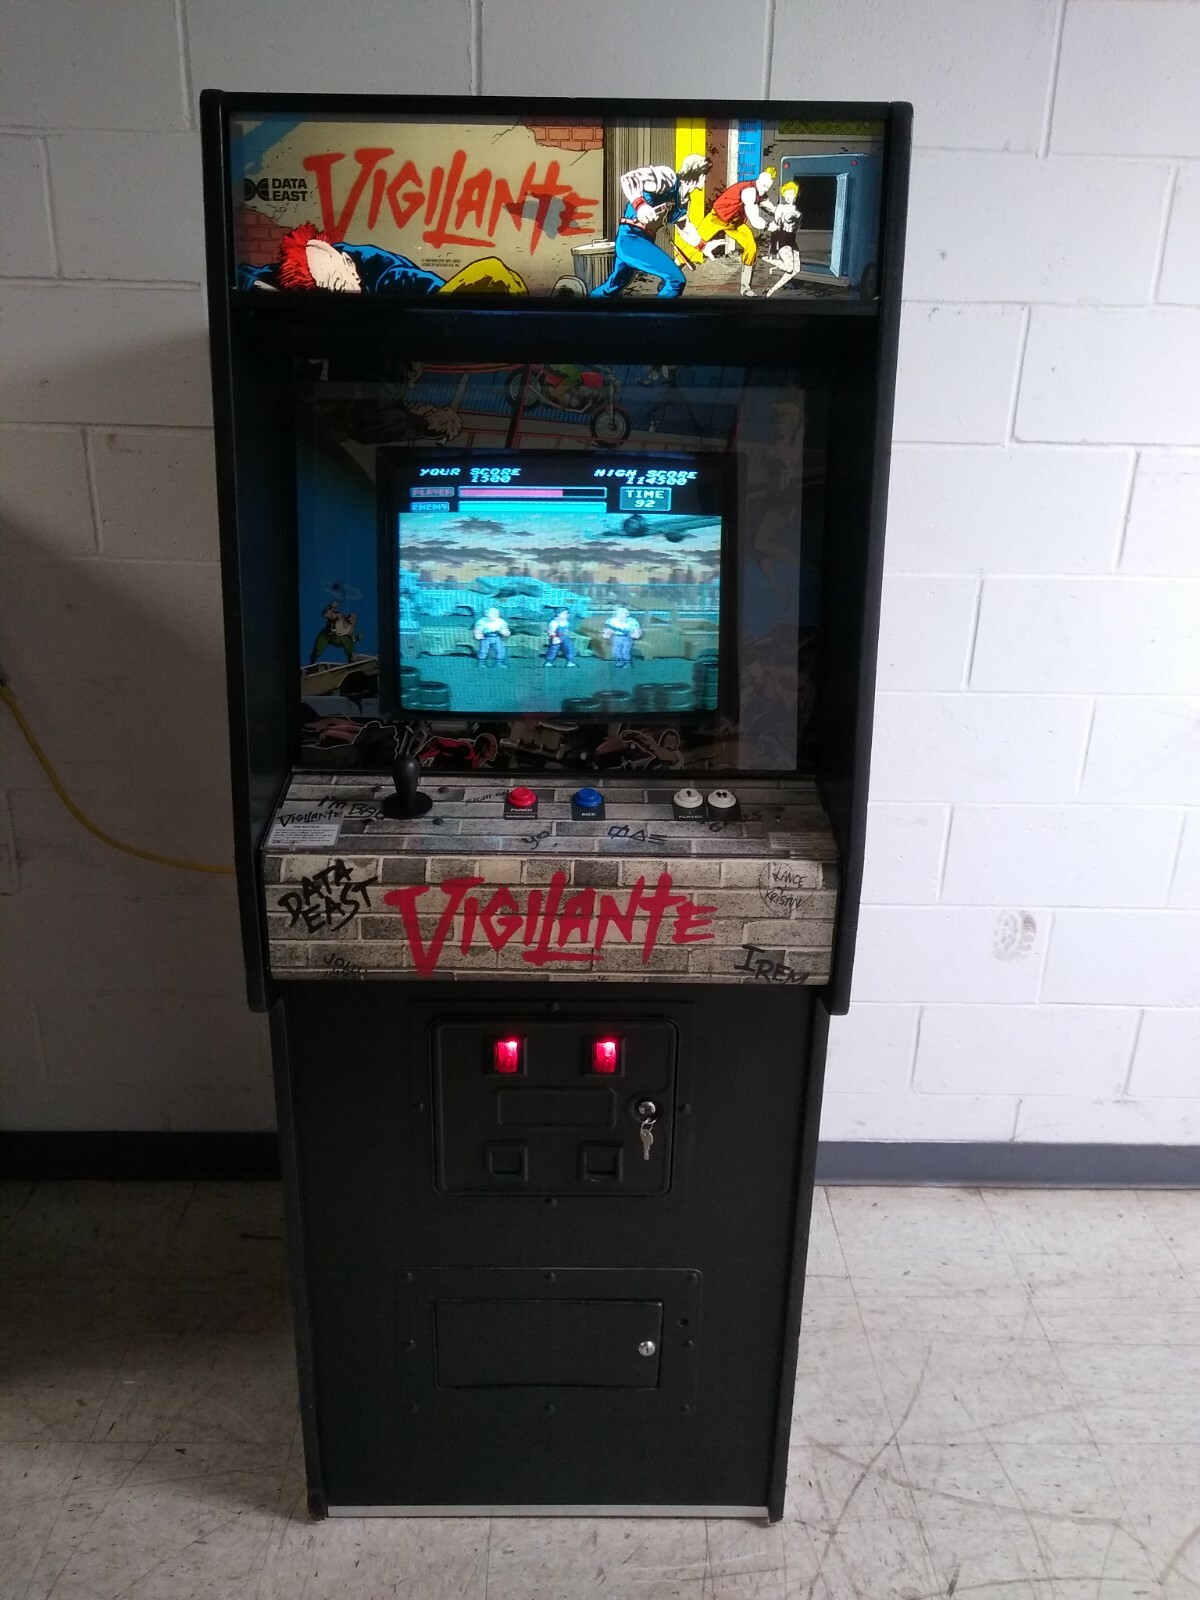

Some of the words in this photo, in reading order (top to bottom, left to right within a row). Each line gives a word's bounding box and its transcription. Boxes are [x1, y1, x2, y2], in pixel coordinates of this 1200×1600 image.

[271, 178, 308, 189] DATA
[272, 190, 308, 202] EAST
[303, 147, 600, 255] VIGILANTE
[419, 467, 461, 476] YOUR
[469, 467, 522, 476] SCORE
[593, 469, 638, 477] HIGH
[645, 469, 699, 480] SCORE
[412, 488, 453, 496] PLAYER
[625, 490, 665, 499] TIME
[634, 499, 657, 508] 92
[278, 858, 354, 927] DATA
[301, 876, 378, 934] EAST
[384, 869, 719, 979] VIGILANTE
[734, 943, 811, 985] IREM
